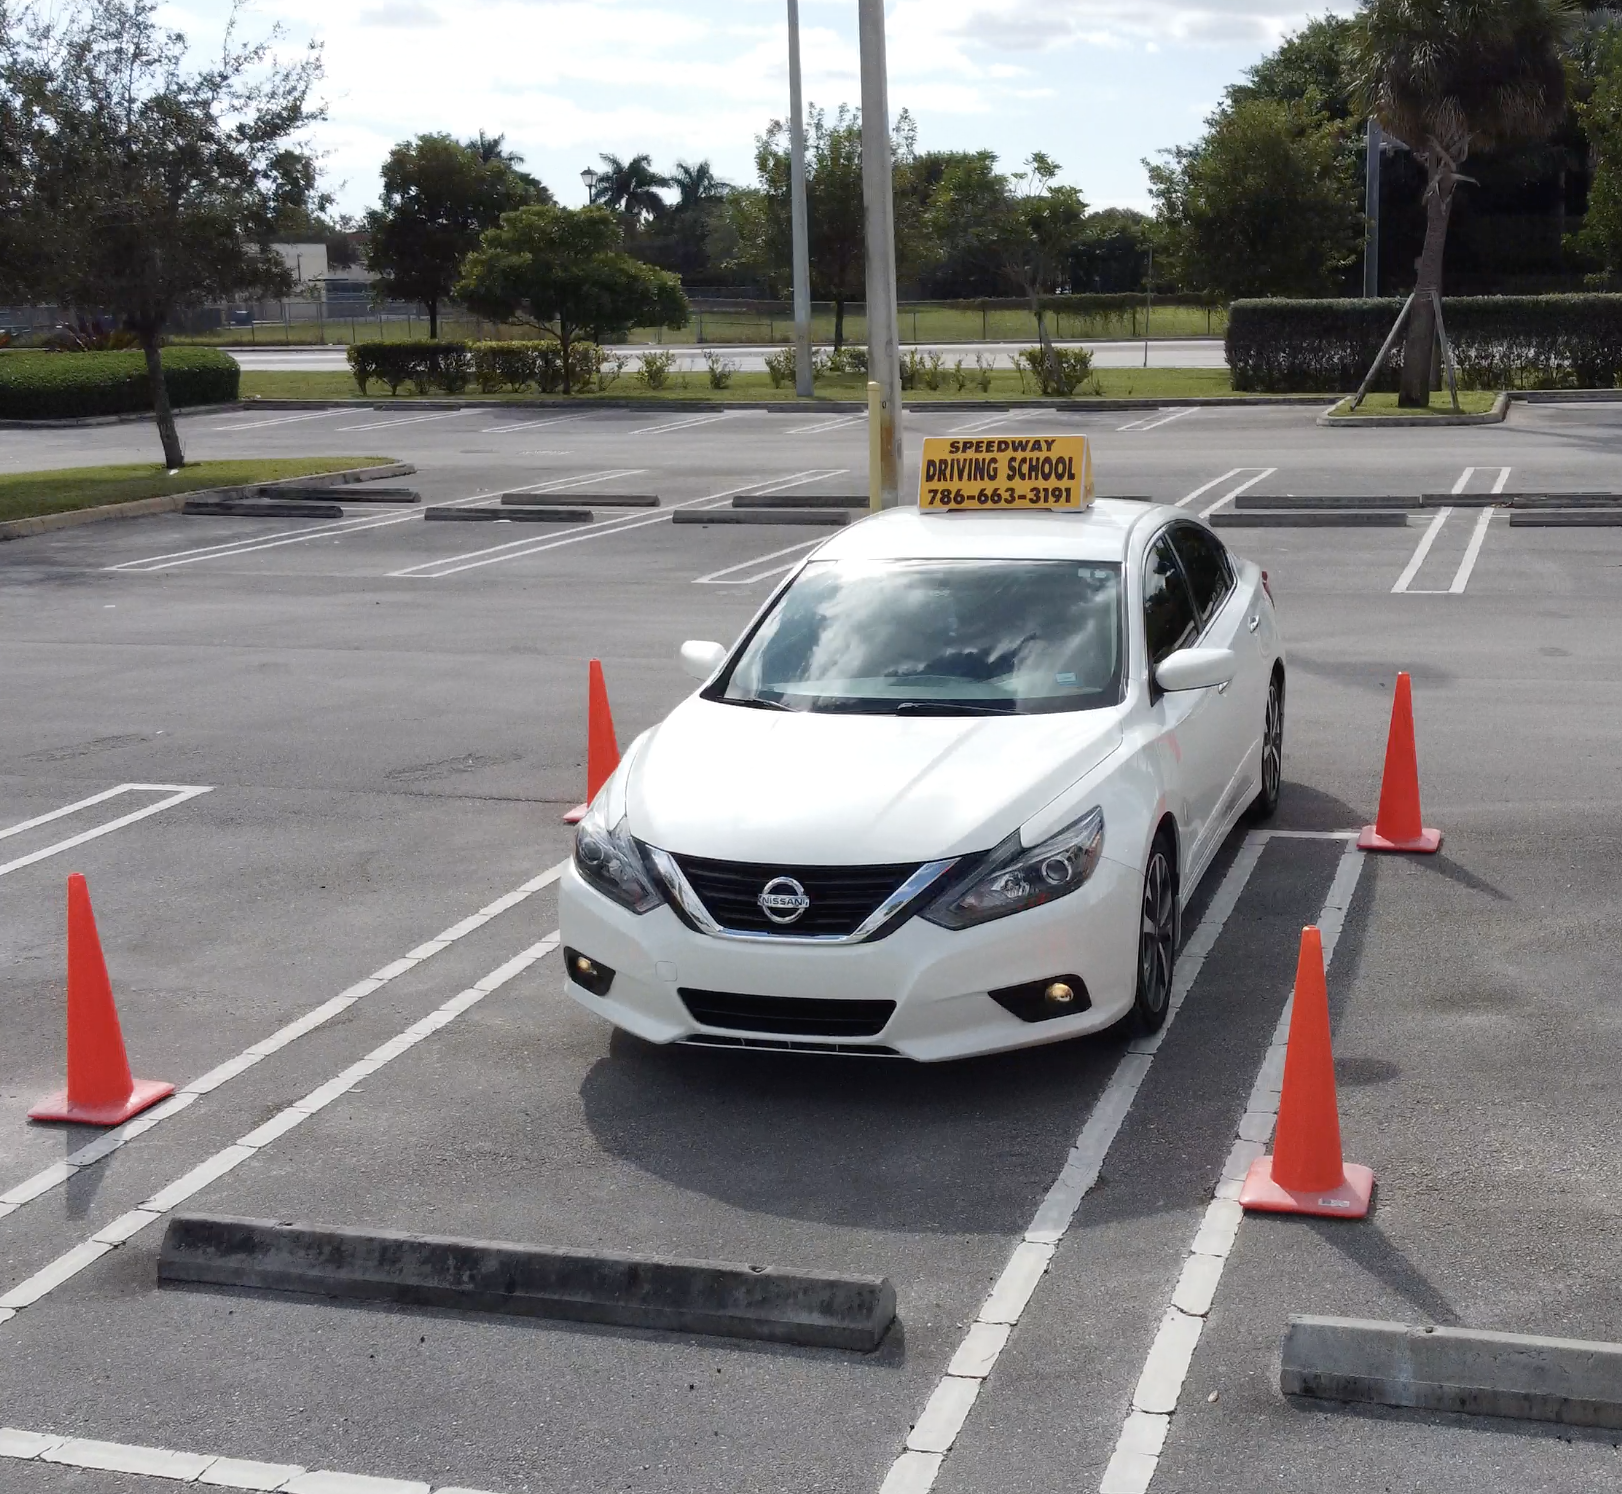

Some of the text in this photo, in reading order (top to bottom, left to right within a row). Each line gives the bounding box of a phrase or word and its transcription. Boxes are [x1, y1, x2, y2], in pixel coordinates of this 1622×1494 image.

[949, 439, 1056, 454] SPEEDWAY
[925, 456, 1075, 482] DRIVING SCHOOL
[928, 487, 1071, 505] 786-663-3191
[762, 897, 803, 906] NISSAN
